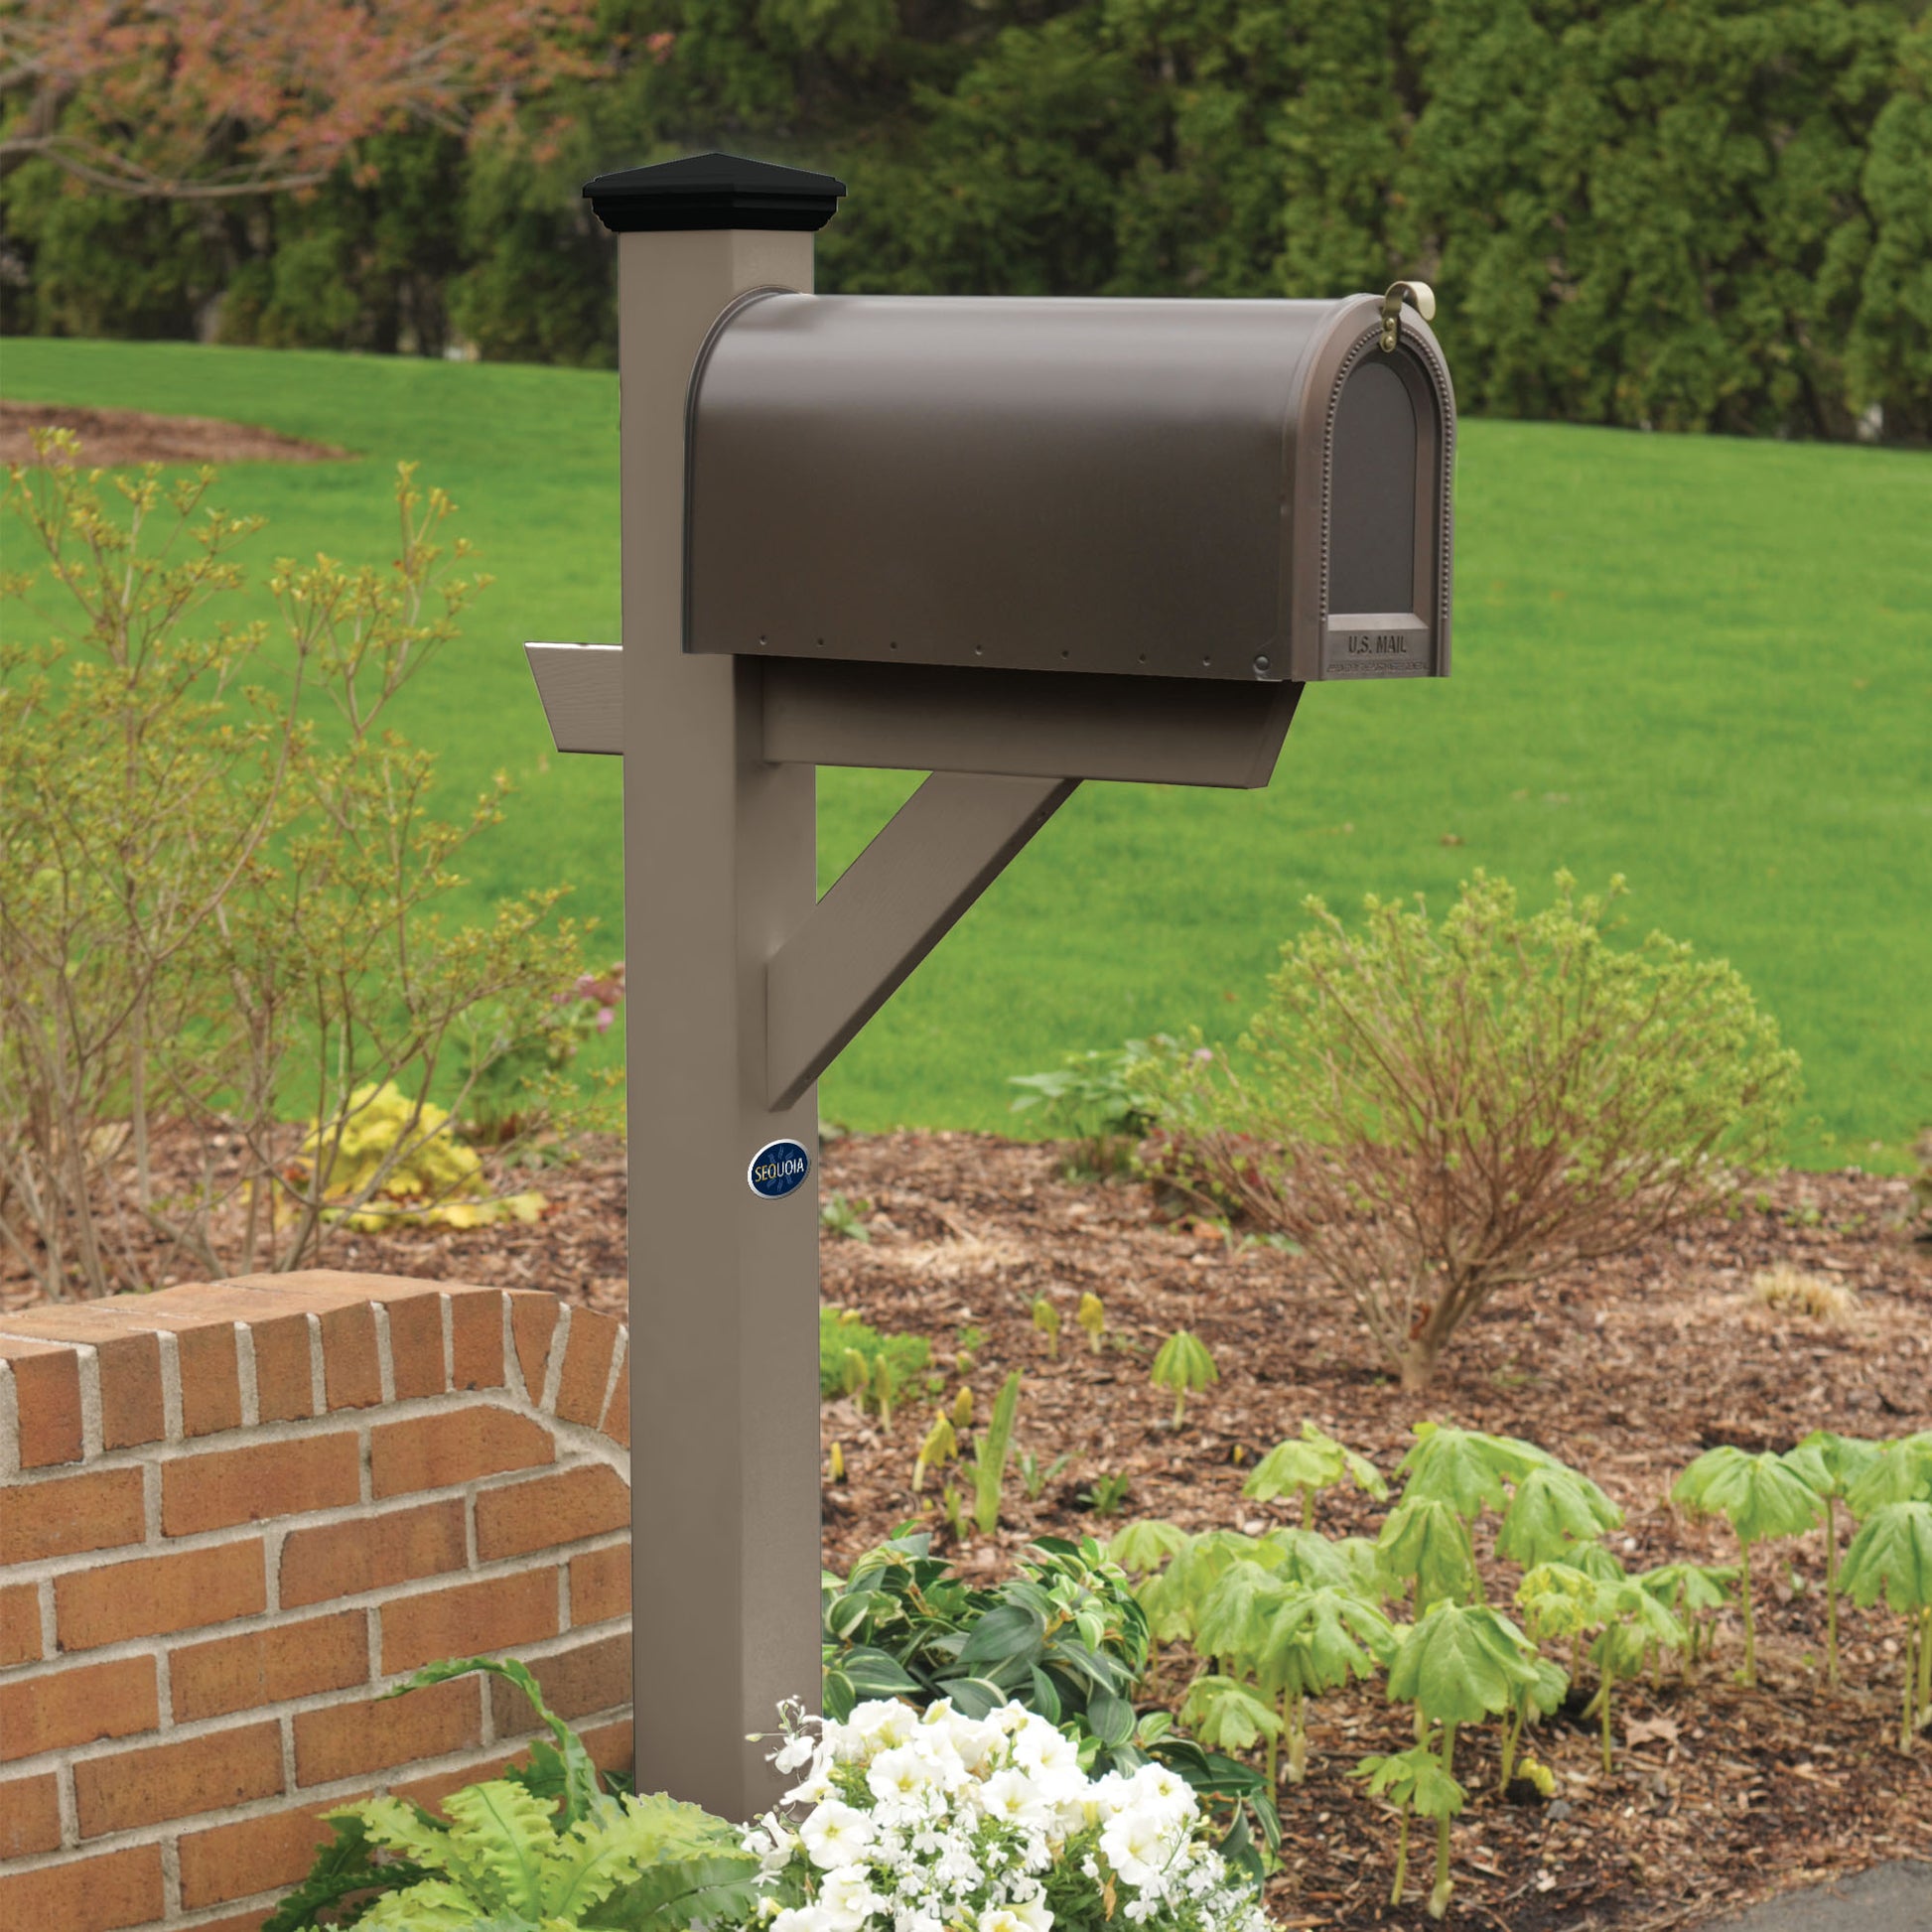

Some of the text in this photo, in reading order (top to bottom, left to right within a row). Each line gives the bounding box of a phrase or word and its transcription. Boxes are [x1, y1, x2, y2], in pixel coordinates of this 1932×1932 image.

[1348, 635, 1407, 654] U.S. MAIL
[755, 1158, 804, 1182] SEQUOIA
